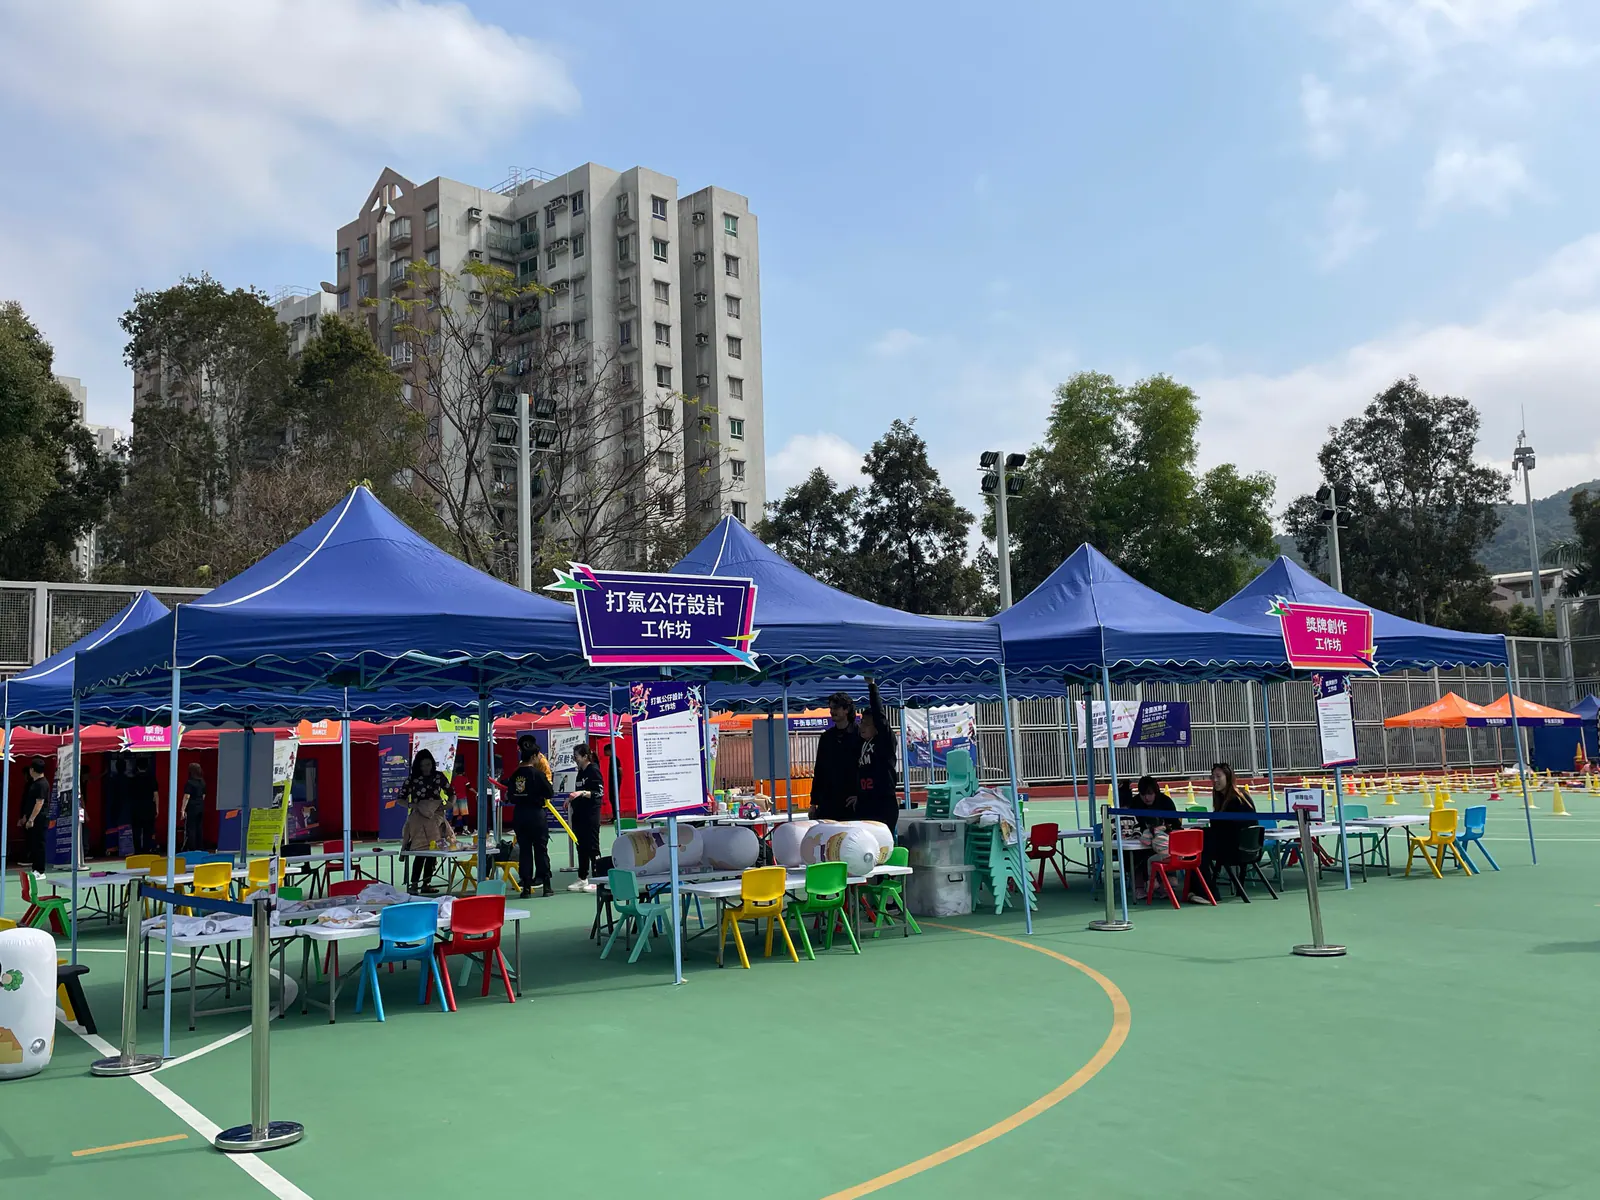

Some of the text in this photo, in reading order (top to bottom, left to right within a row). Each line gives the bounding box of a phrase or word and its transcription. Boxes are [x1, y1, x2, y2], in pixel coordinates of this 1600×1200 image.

[605, 589, 725, 617] 打氣公仔設計
[640, 620, 692, 639] 工作坊
[1305, 616, 1348, 636] 獎牌創作
[1314, 637, 1342, 652] 工作坊
[650, 692, 684, 706] 打氣公仔設計
[659, 703, 676, 713] 工作坊
